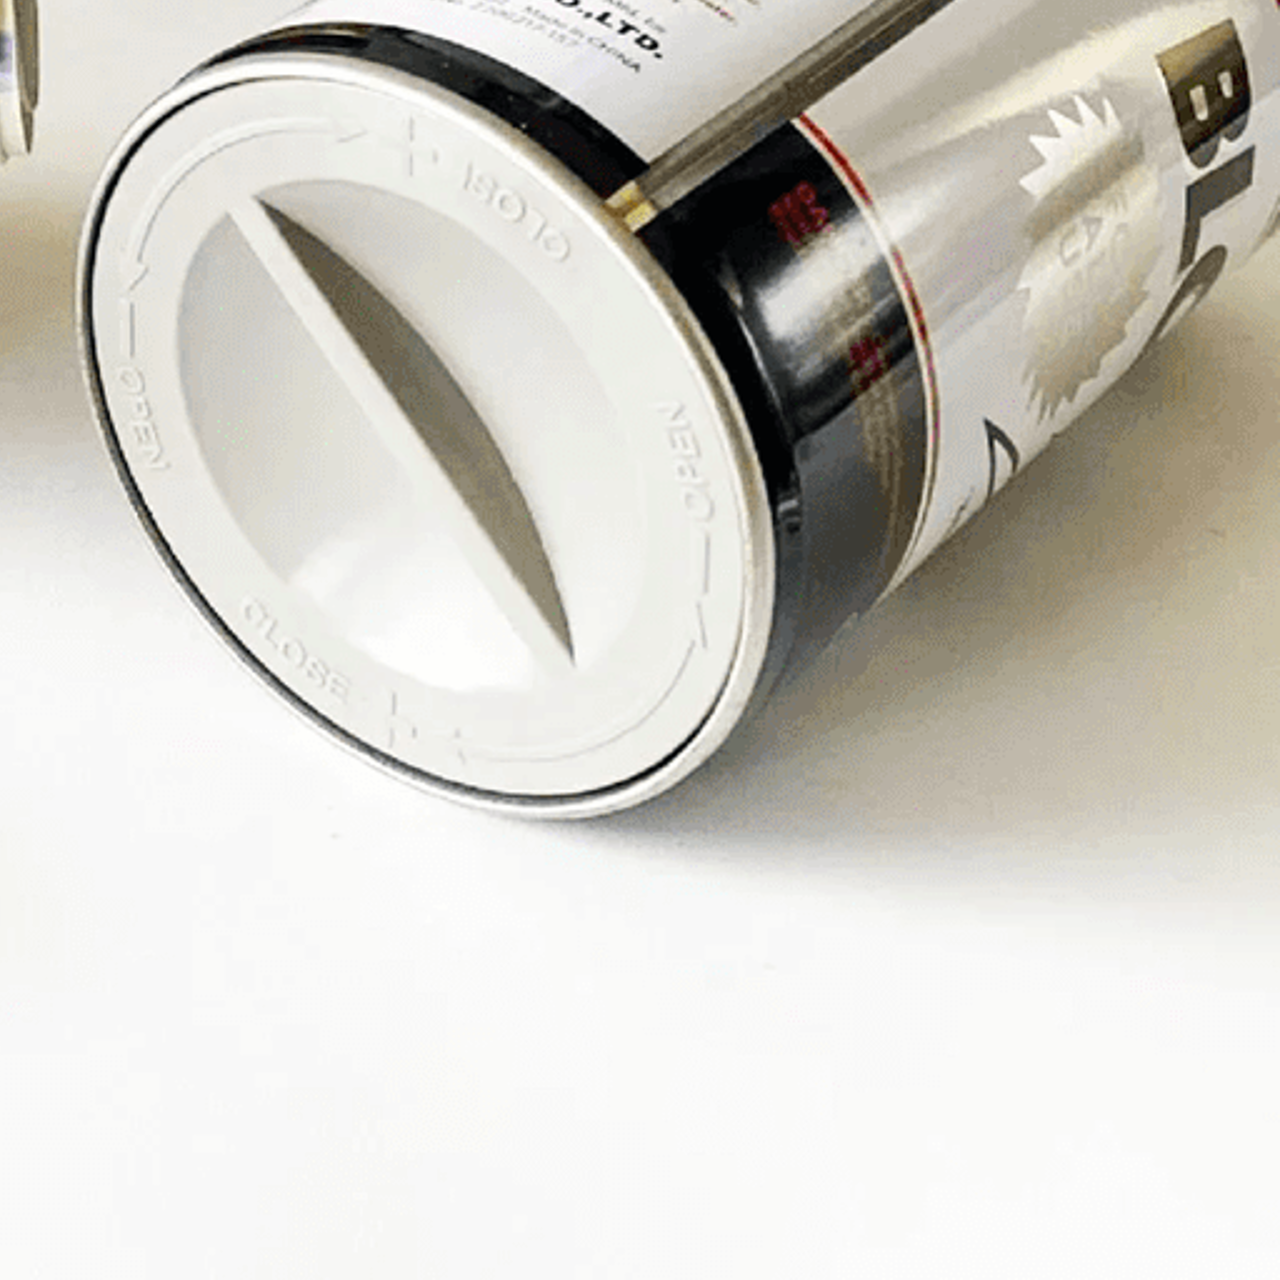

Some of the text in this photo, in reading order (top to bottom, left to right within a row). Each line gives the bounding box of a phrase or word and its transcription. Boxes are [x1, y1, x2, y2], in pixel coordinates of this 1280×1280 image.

[588, 37, 641, 73] CHINA
[116, 365, 174, 472] OPEN
[240, 593, 353, 706] CLOSE
